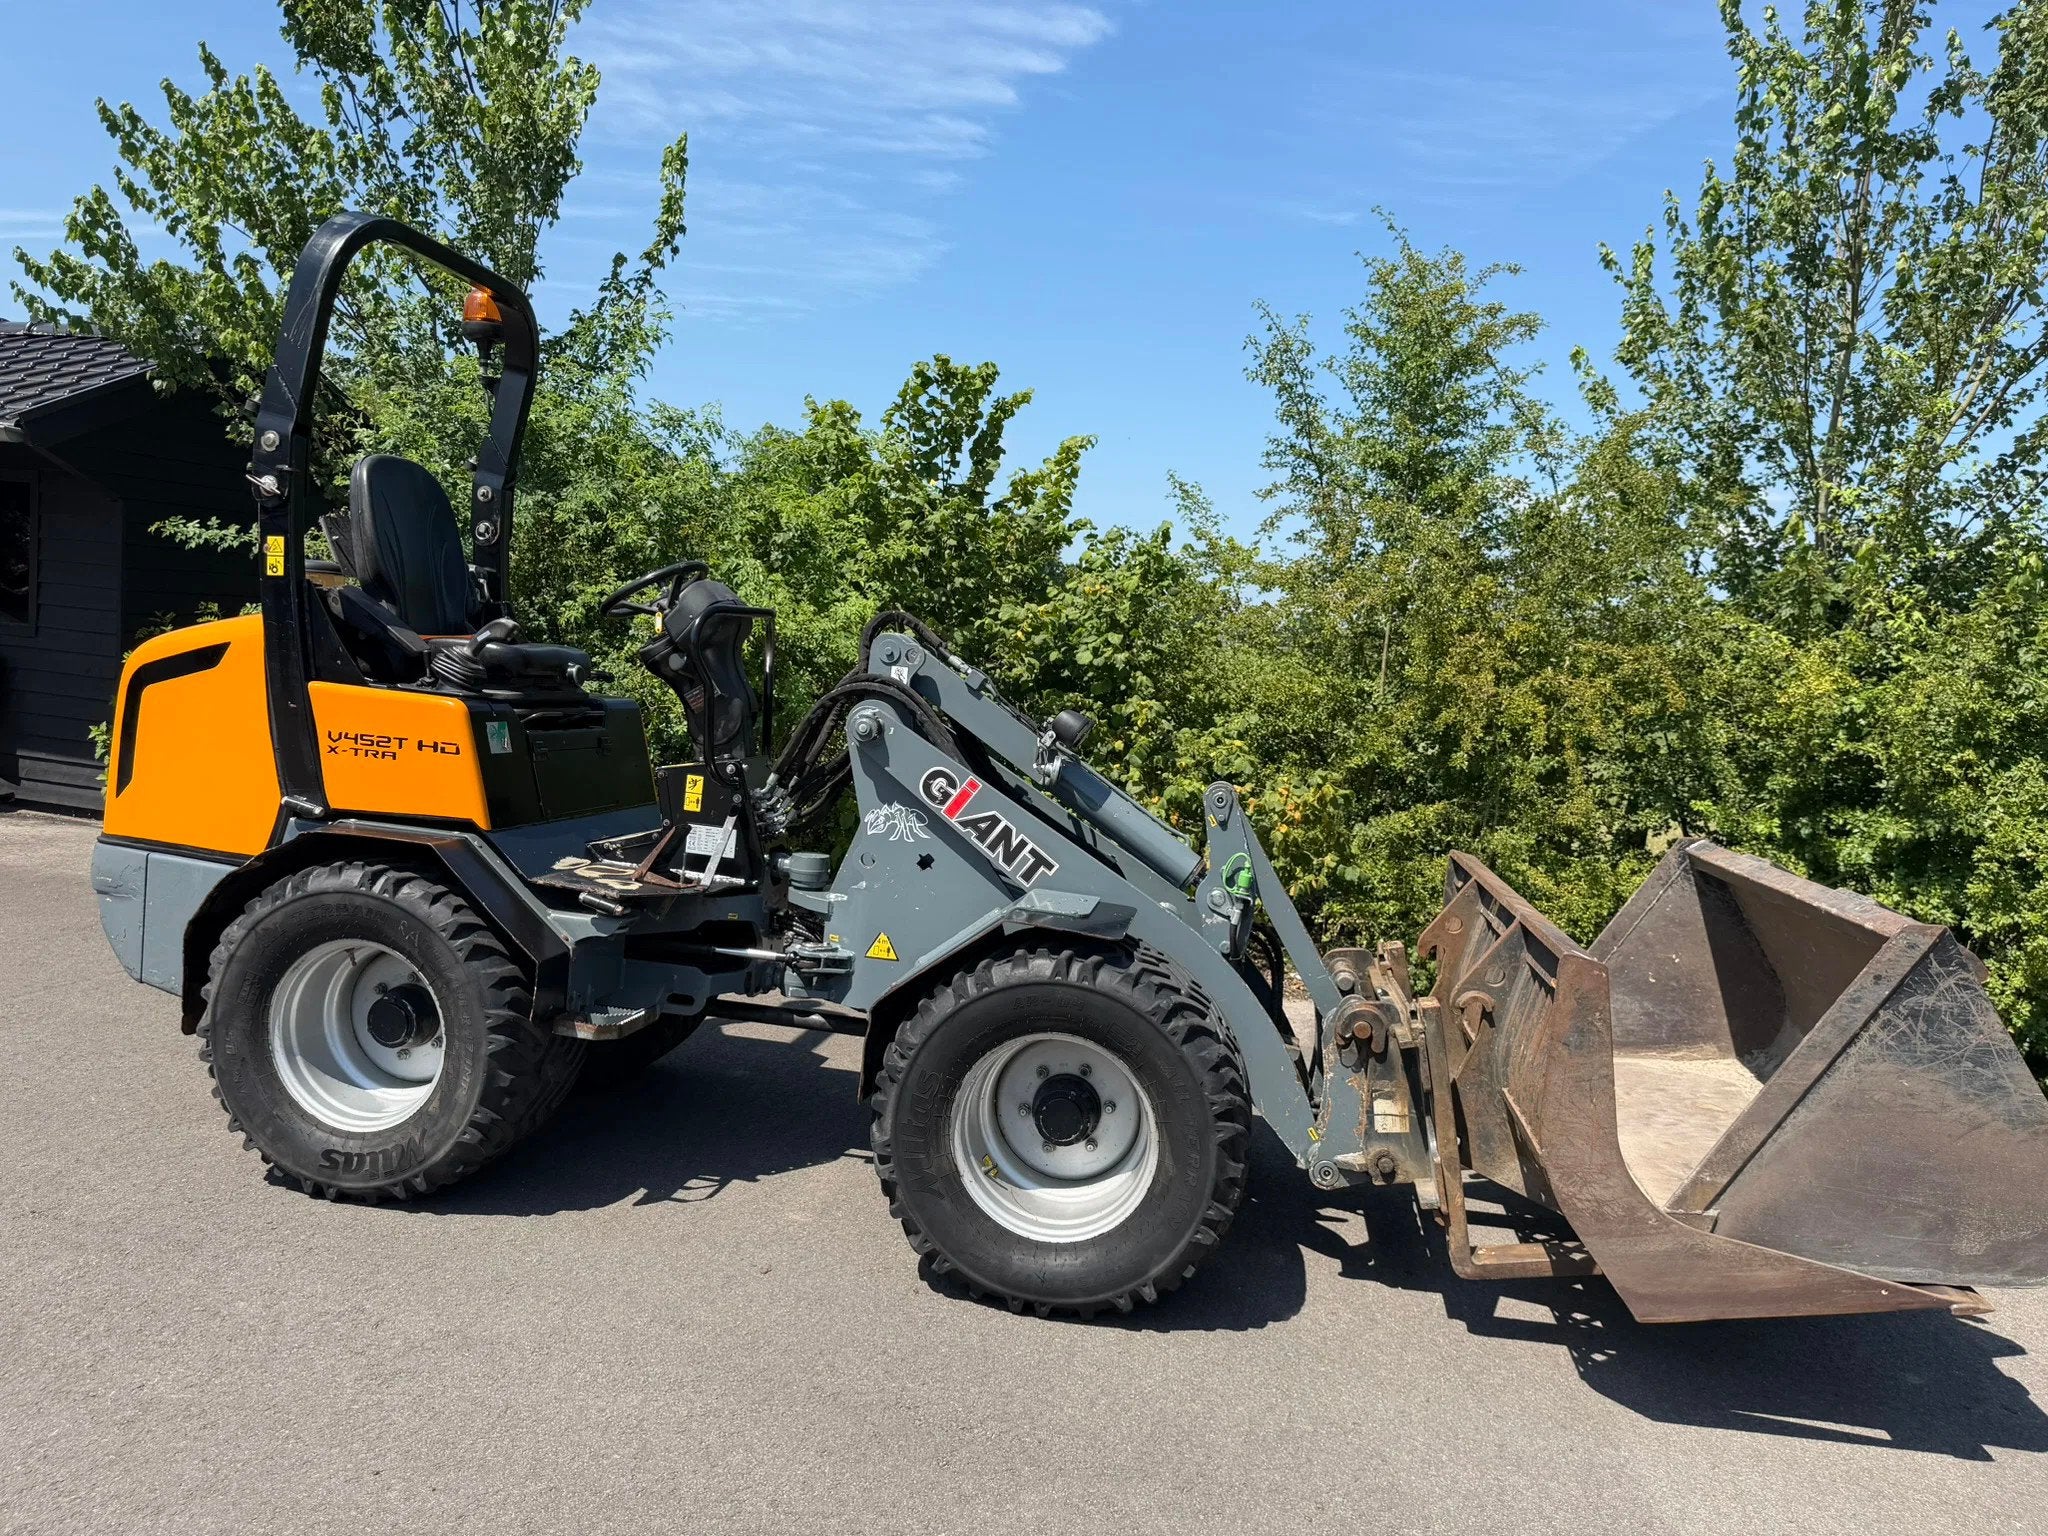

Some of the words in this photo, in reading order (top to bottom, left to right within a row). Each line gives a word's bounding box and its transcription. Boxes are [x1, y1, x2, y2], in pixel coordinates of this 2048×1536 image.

[327, 730, 408, 750] V452T
[417, 739, 460, 756] HD
[327, 745, 397, 760] X-TRA
[318, 1127, 427, 1181] Mitas
[900, 1069, 946, 1199] Mitas
